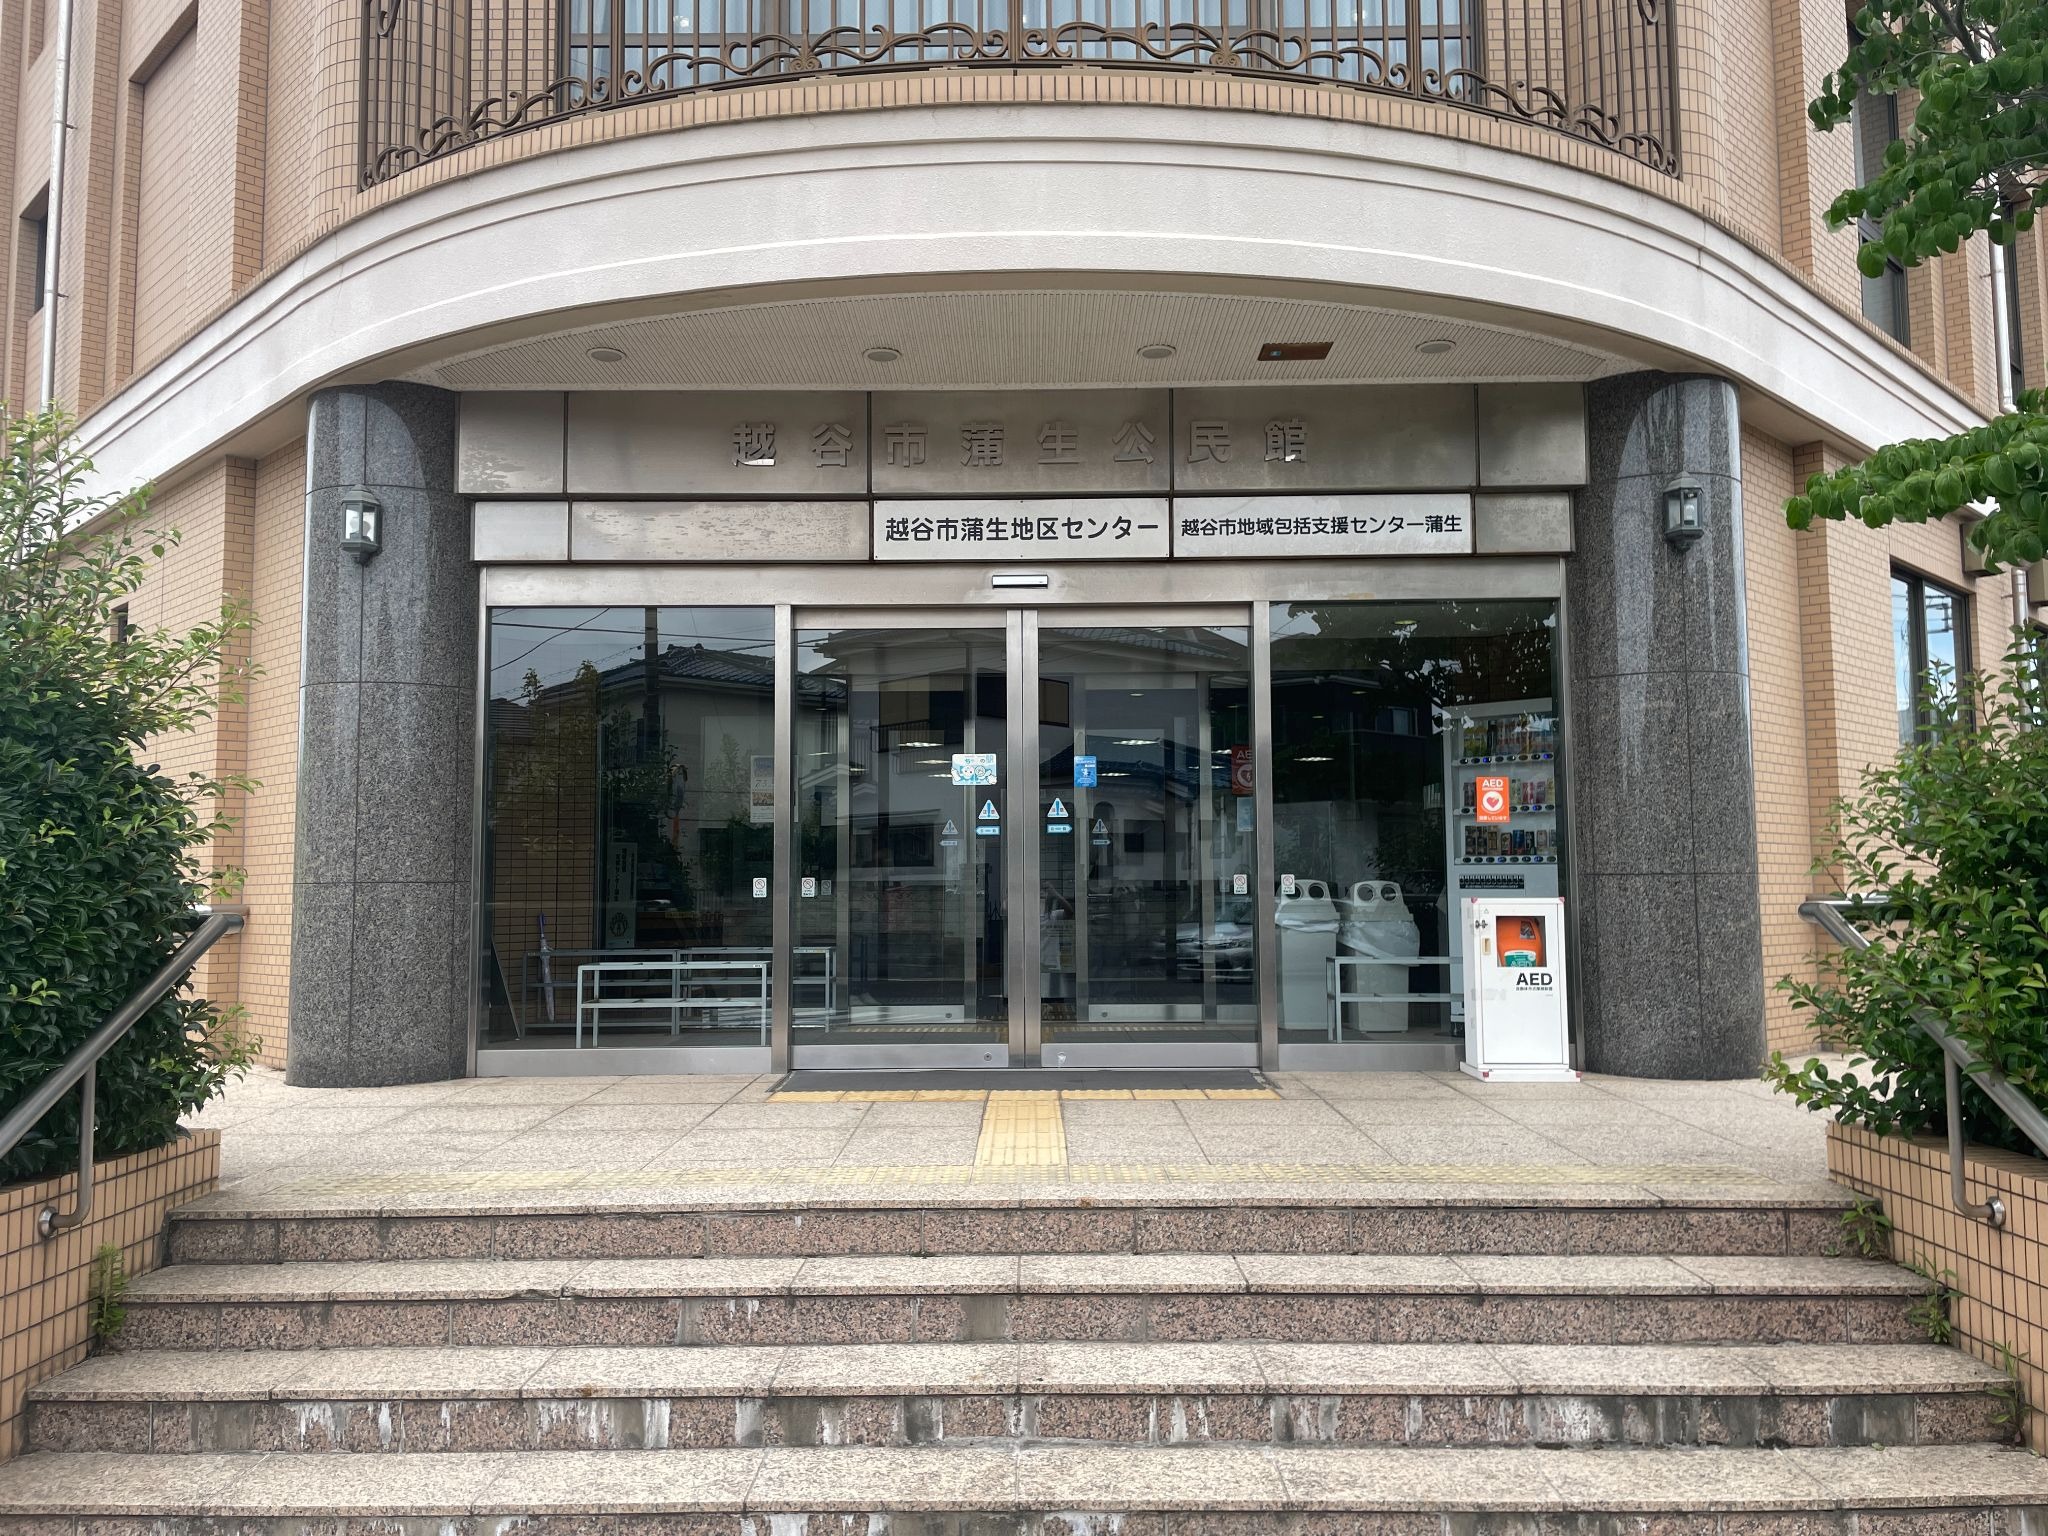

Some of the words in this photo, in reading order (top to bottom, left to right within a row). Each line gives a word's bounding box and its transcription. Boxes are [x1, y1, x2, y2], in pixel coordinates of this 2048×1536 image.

[732, 418, 1308, 468] 越谷市蒲生公民館
[885, 515, 1160, 542] 越谷市蒲生地区センター
[1181, 514, 1463, 537] 越谷市地域包括支援センター蒲生
[1482, 779, 1504, 788] AED
[1516, 973, 1553, 986] AED
